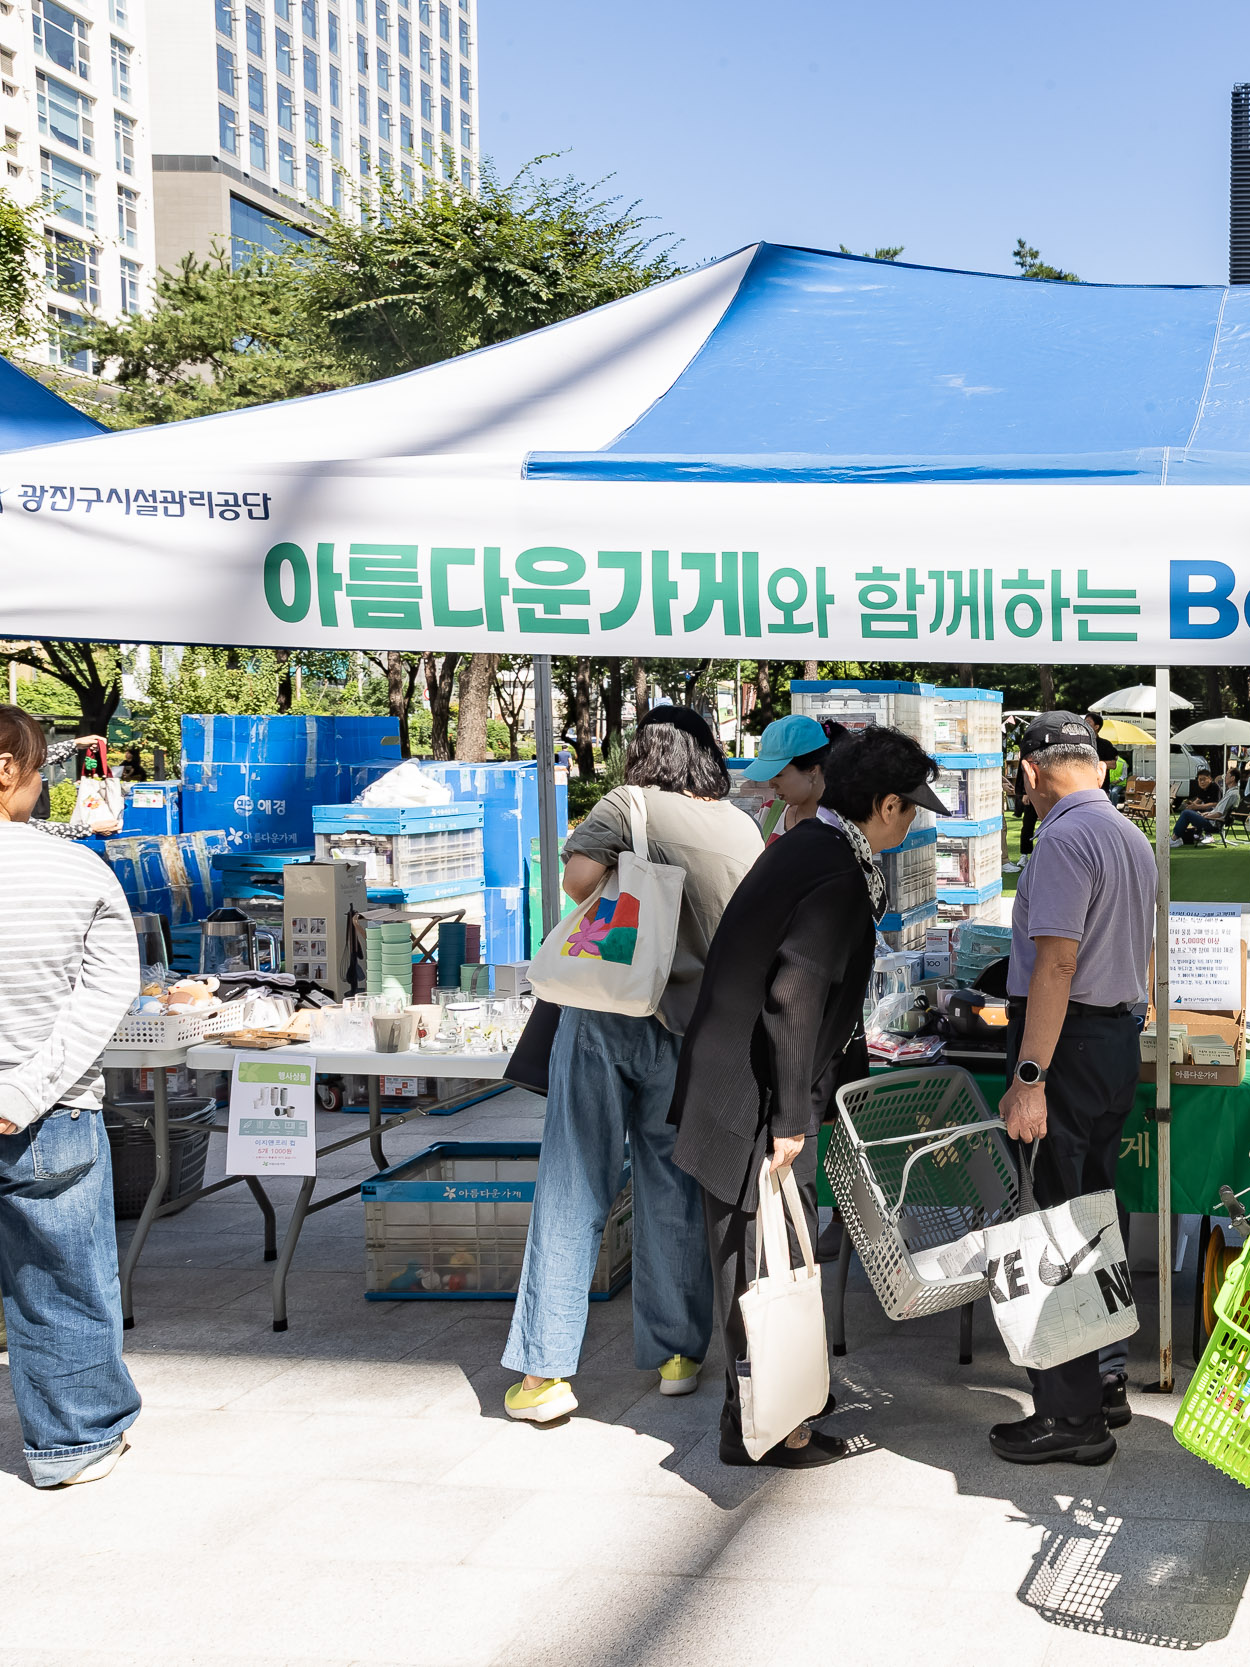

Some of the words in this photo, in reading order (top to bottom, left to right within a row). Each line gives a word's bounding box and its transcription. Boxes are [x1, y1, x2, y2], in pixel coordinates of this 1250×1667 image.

[17, 483, 272, 521] 광진구시설관리공단
[263, 541, 835, 639] 아름다운가게와
[855, 566, 1142, 642] 함께하는
[257, 799, 286, 816] 애경
[243, 831, 298, 845] 아름다운가게
[1181, 937, 1206, 945] 5,000원
[1207, 937, 1220, 945] 이상
[278, 1071, 307, 1082] 행사상품
[1175, 1069, 1218, 1080] 아름다운가게
[458, 1188, 522, 1199] 아름다운가게
